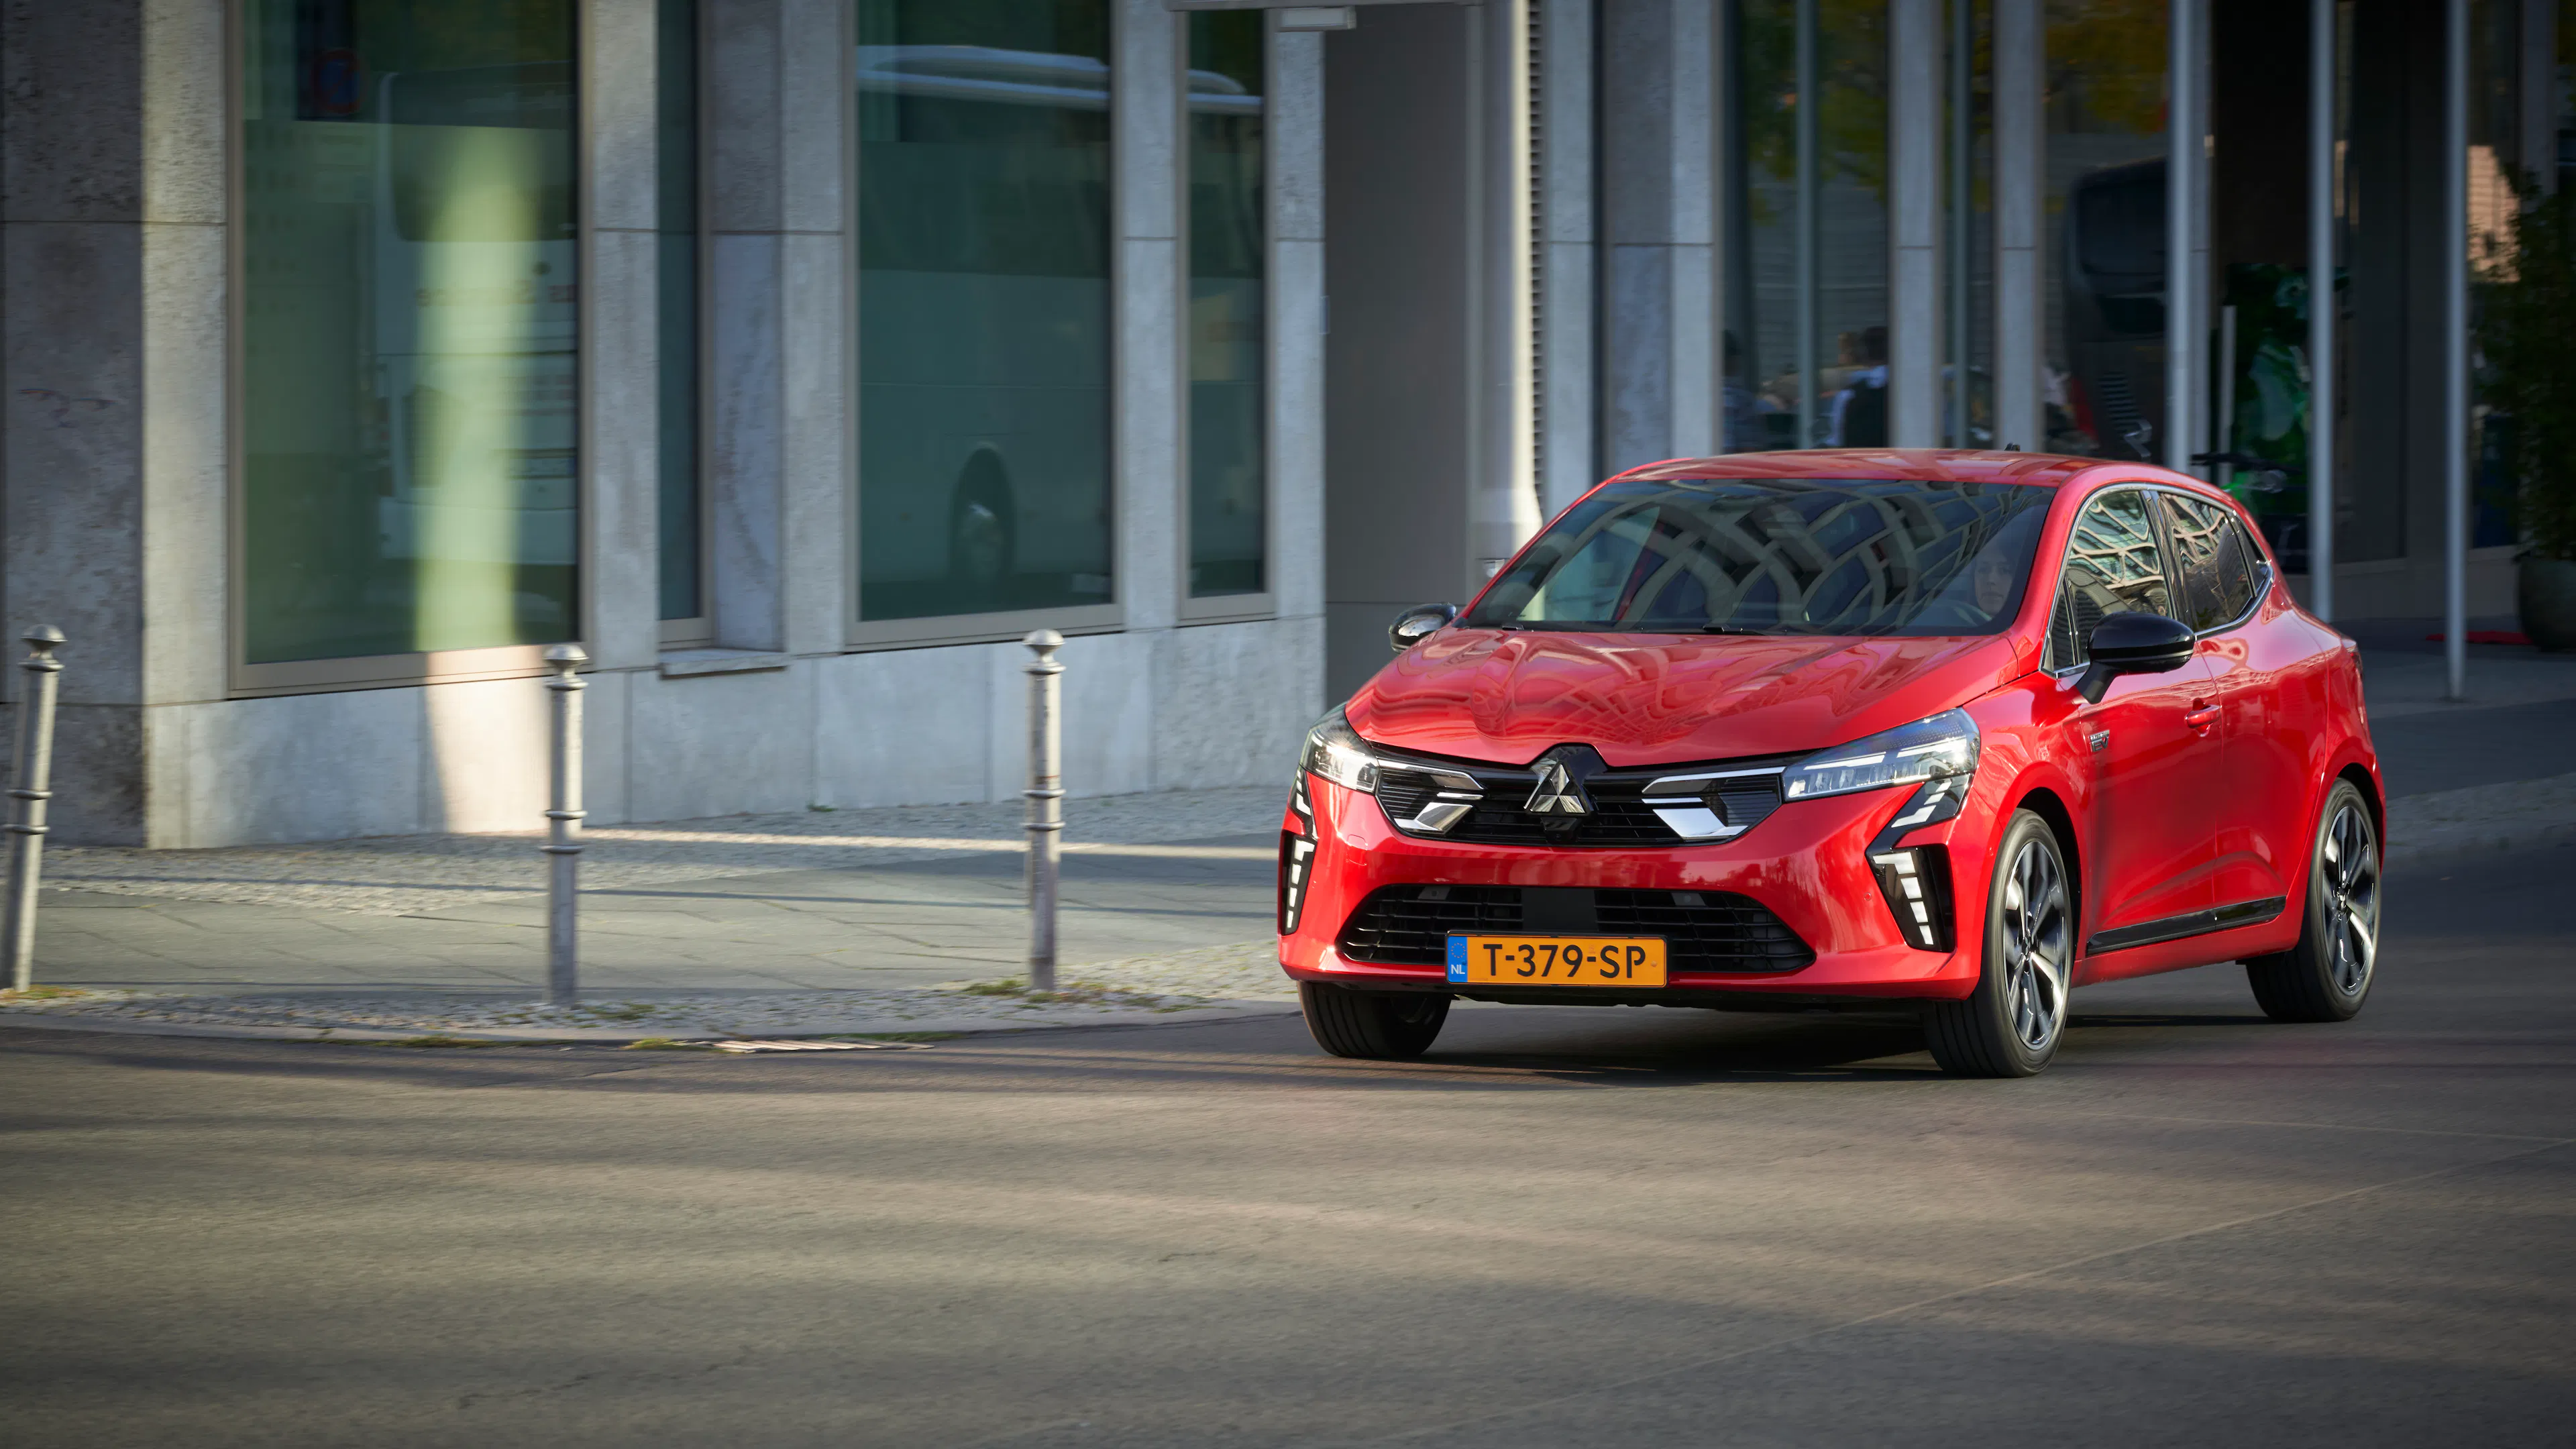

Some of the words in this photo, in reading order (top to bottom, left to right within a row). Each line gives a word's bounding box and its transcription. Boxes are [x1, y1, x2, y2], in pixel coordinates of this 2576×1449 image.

[2092, 735, 2108, 751] EV
[1483, 944, 1646, 978] T-379-SP
[1451, 964, 1466, 975] NL
